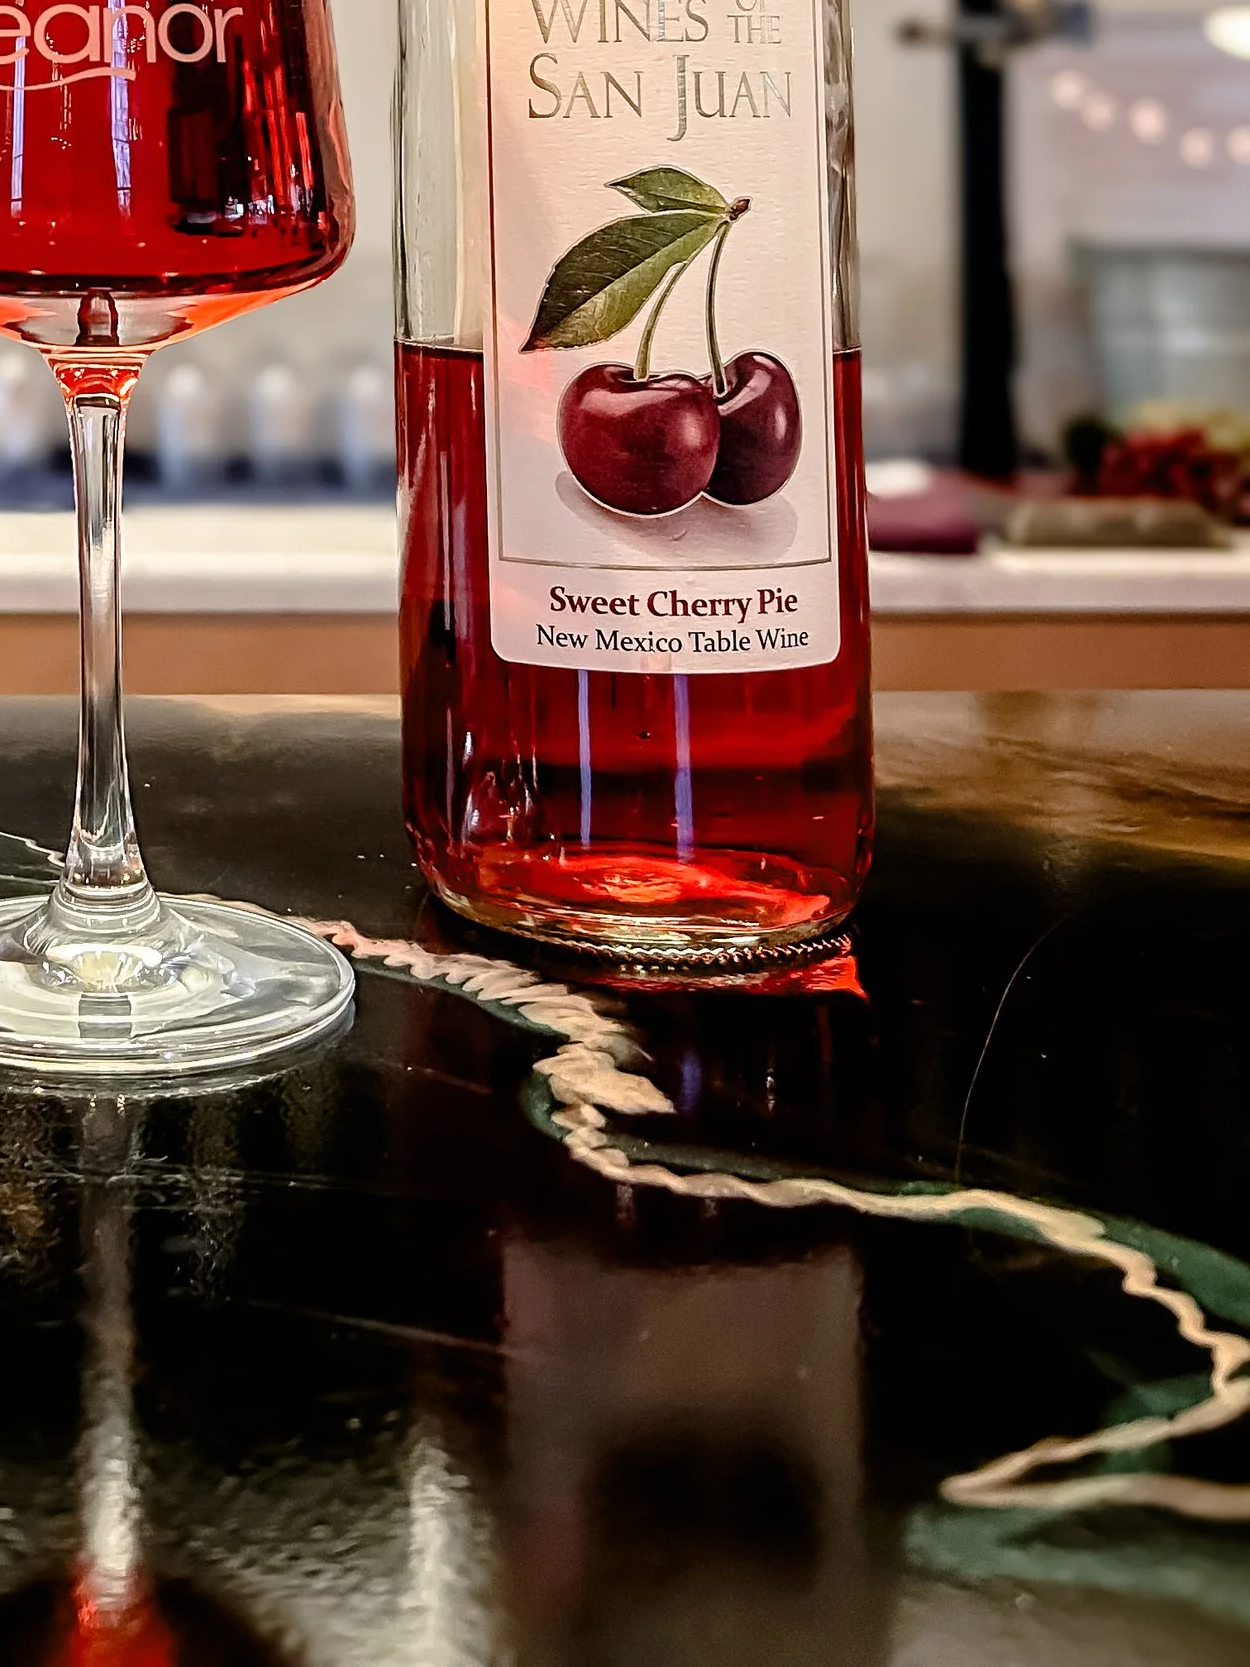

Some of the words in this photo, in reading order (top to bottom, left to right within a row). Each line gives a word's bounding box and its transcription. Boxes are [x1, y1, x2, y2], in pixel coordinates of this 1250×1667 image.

[727, 14, 782, 44] THE
[528, 52, 644, 119] SAN
[666, 54, 792, 142] JUAN
[550, 586, 639, 616] Sweet
[647, 590, 752, 623] Cherry
[757, 587, 798, 615] Pie
[536, 624, 588, 648] New
[596, 629, 682, 653] Mexico
[689, 631, 750, 653] Table
[756, 627, 810, 648] Wine
